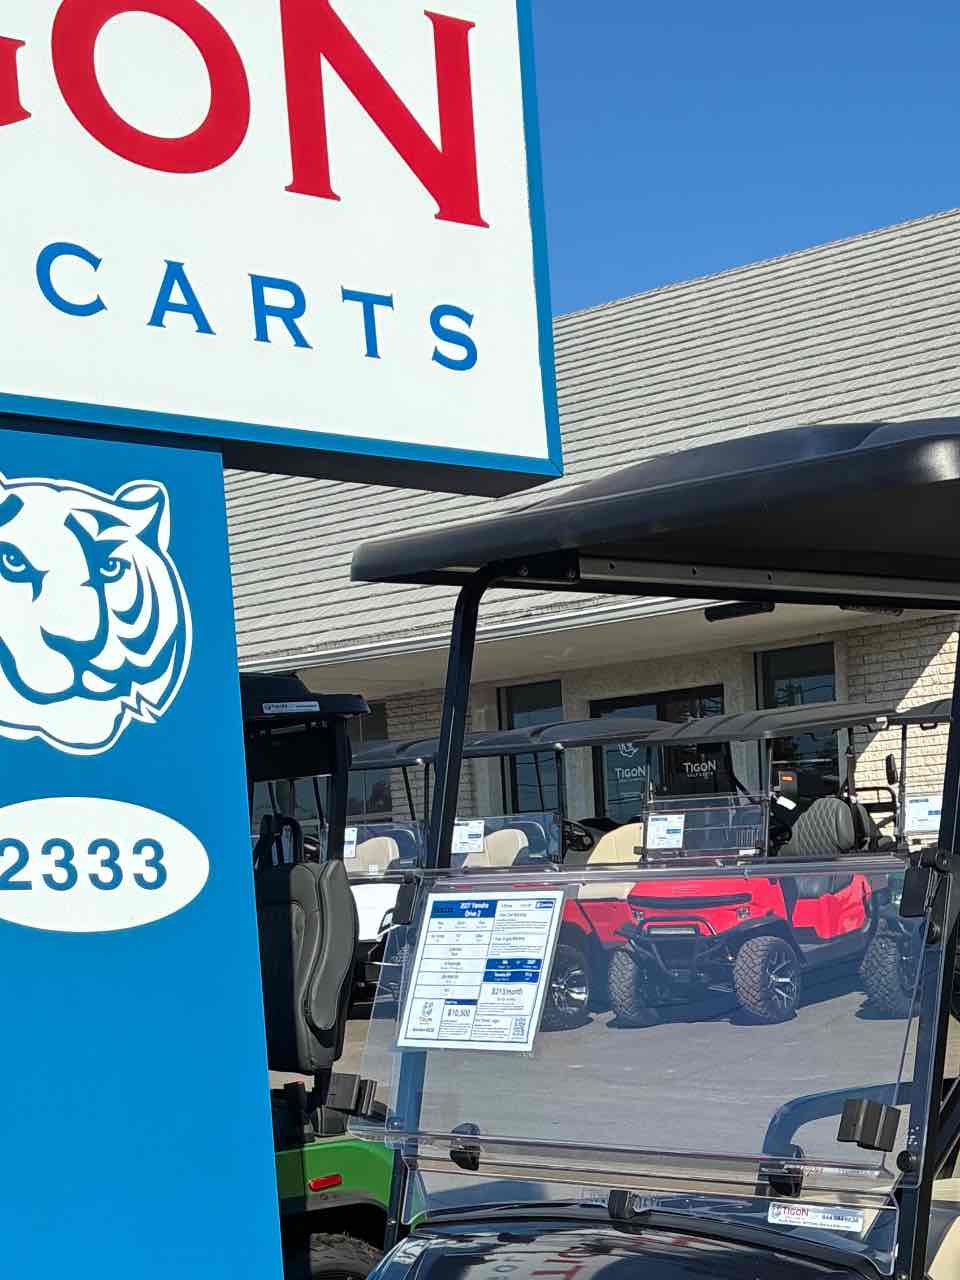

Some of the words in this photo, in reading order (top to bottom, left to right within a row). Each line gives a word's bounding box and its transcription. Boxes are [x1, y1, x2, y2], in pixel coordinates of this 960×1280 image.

[0, 0, 489, 228] ON
[36, 241, 477, 371] CARTS
[615, 766, 646, 779] TIGON
[683, 760, 717, 773] TIGON
[0, 837, 168, 891] 2333
[783, 1207, 809, 1217] TIGON
